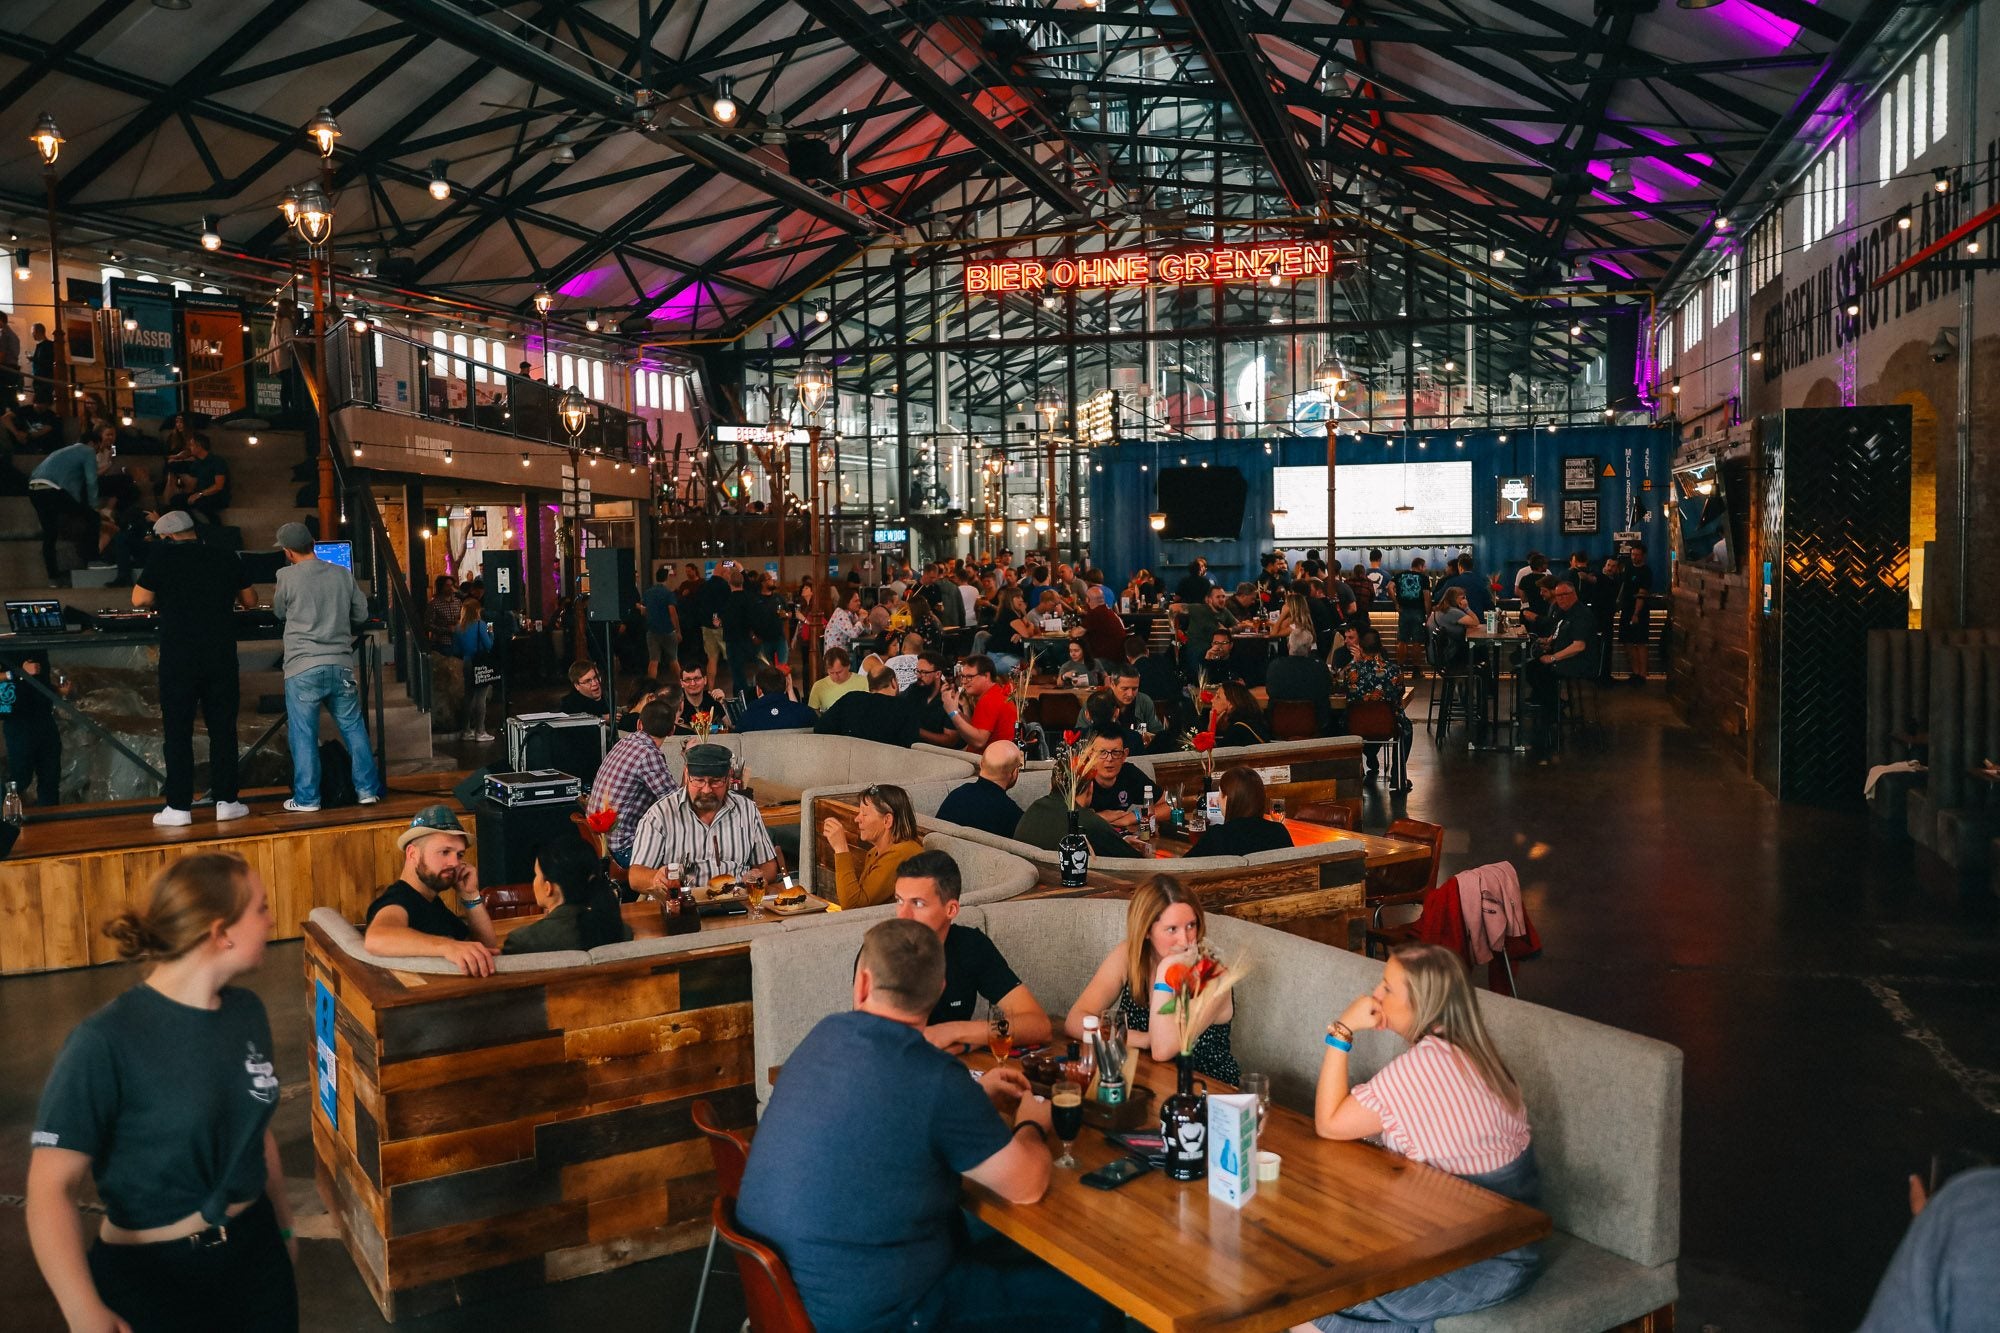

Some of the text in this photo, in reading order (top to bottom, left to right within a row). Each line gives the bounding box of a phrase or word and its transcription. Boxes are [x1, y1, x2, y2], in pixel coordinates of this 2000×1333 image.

[966, 245, 1330, 293] BIER OHNE GRENZEN
[1817, 263, 1832, 358] IN
[122, 328, 172, 349] WASSER
[190, 338, 224, 356] MAZ
[874, 529, 906, 543] BREWDOG
